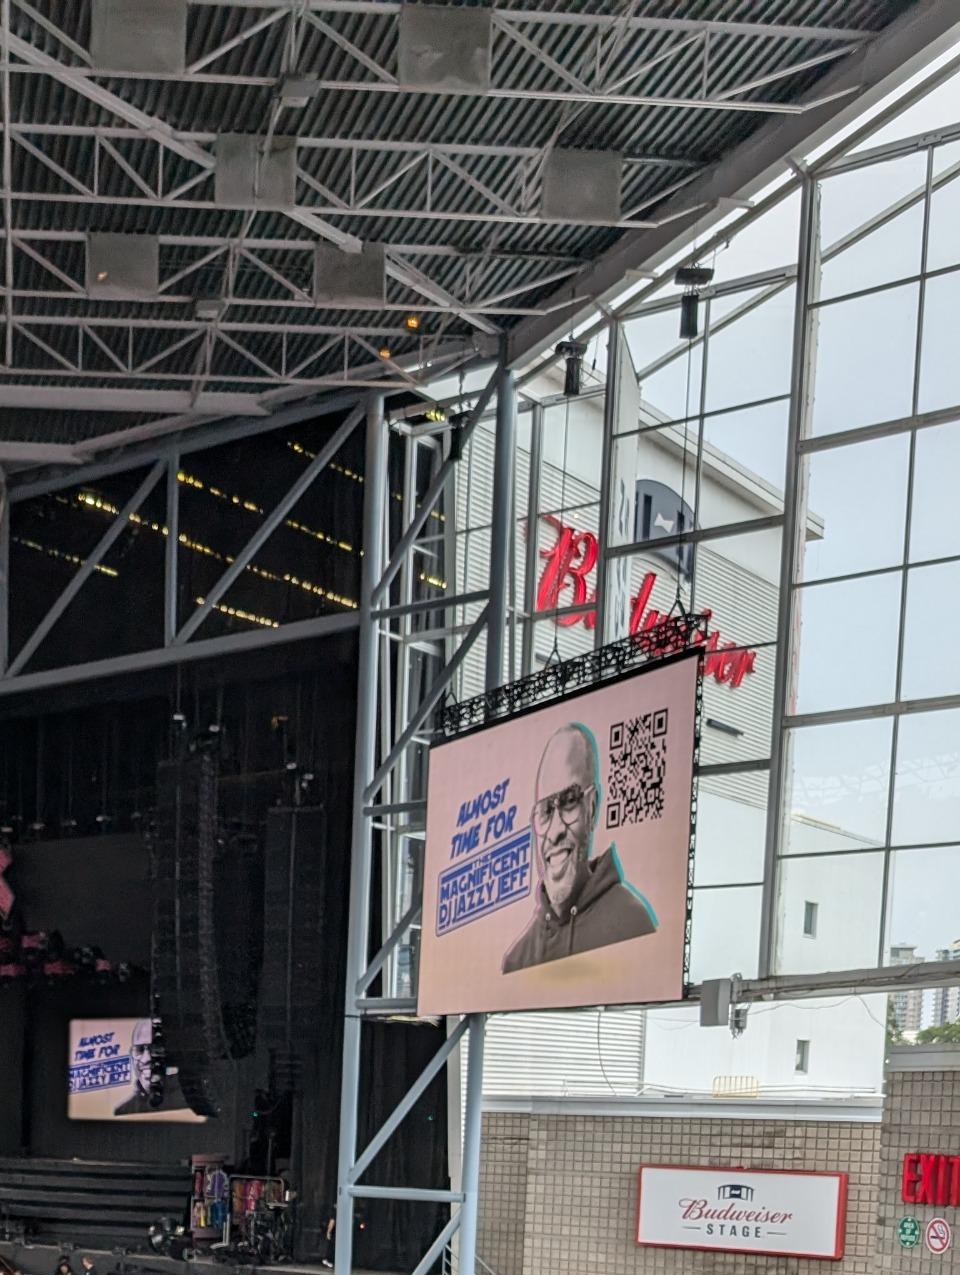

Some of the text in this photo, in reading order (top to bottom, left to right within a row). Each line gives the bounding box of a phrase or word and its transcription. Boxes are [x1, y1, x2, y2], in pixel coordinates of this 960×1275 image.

[456, 778, 510, 827] ALMOST
[450, 805, 517, 859] TIME FOR
[440, 842, 530, 902] MAGNIFICENT
[473, 853, 492, 868] THE
[439, 863, 530, 927] DJ JAZZY JEFF
[902, 1153, 960, 1208] EXIT
[678, 1197, 792, 1224] Budweiser
[706, 1223, 761, 1238] STAGE
